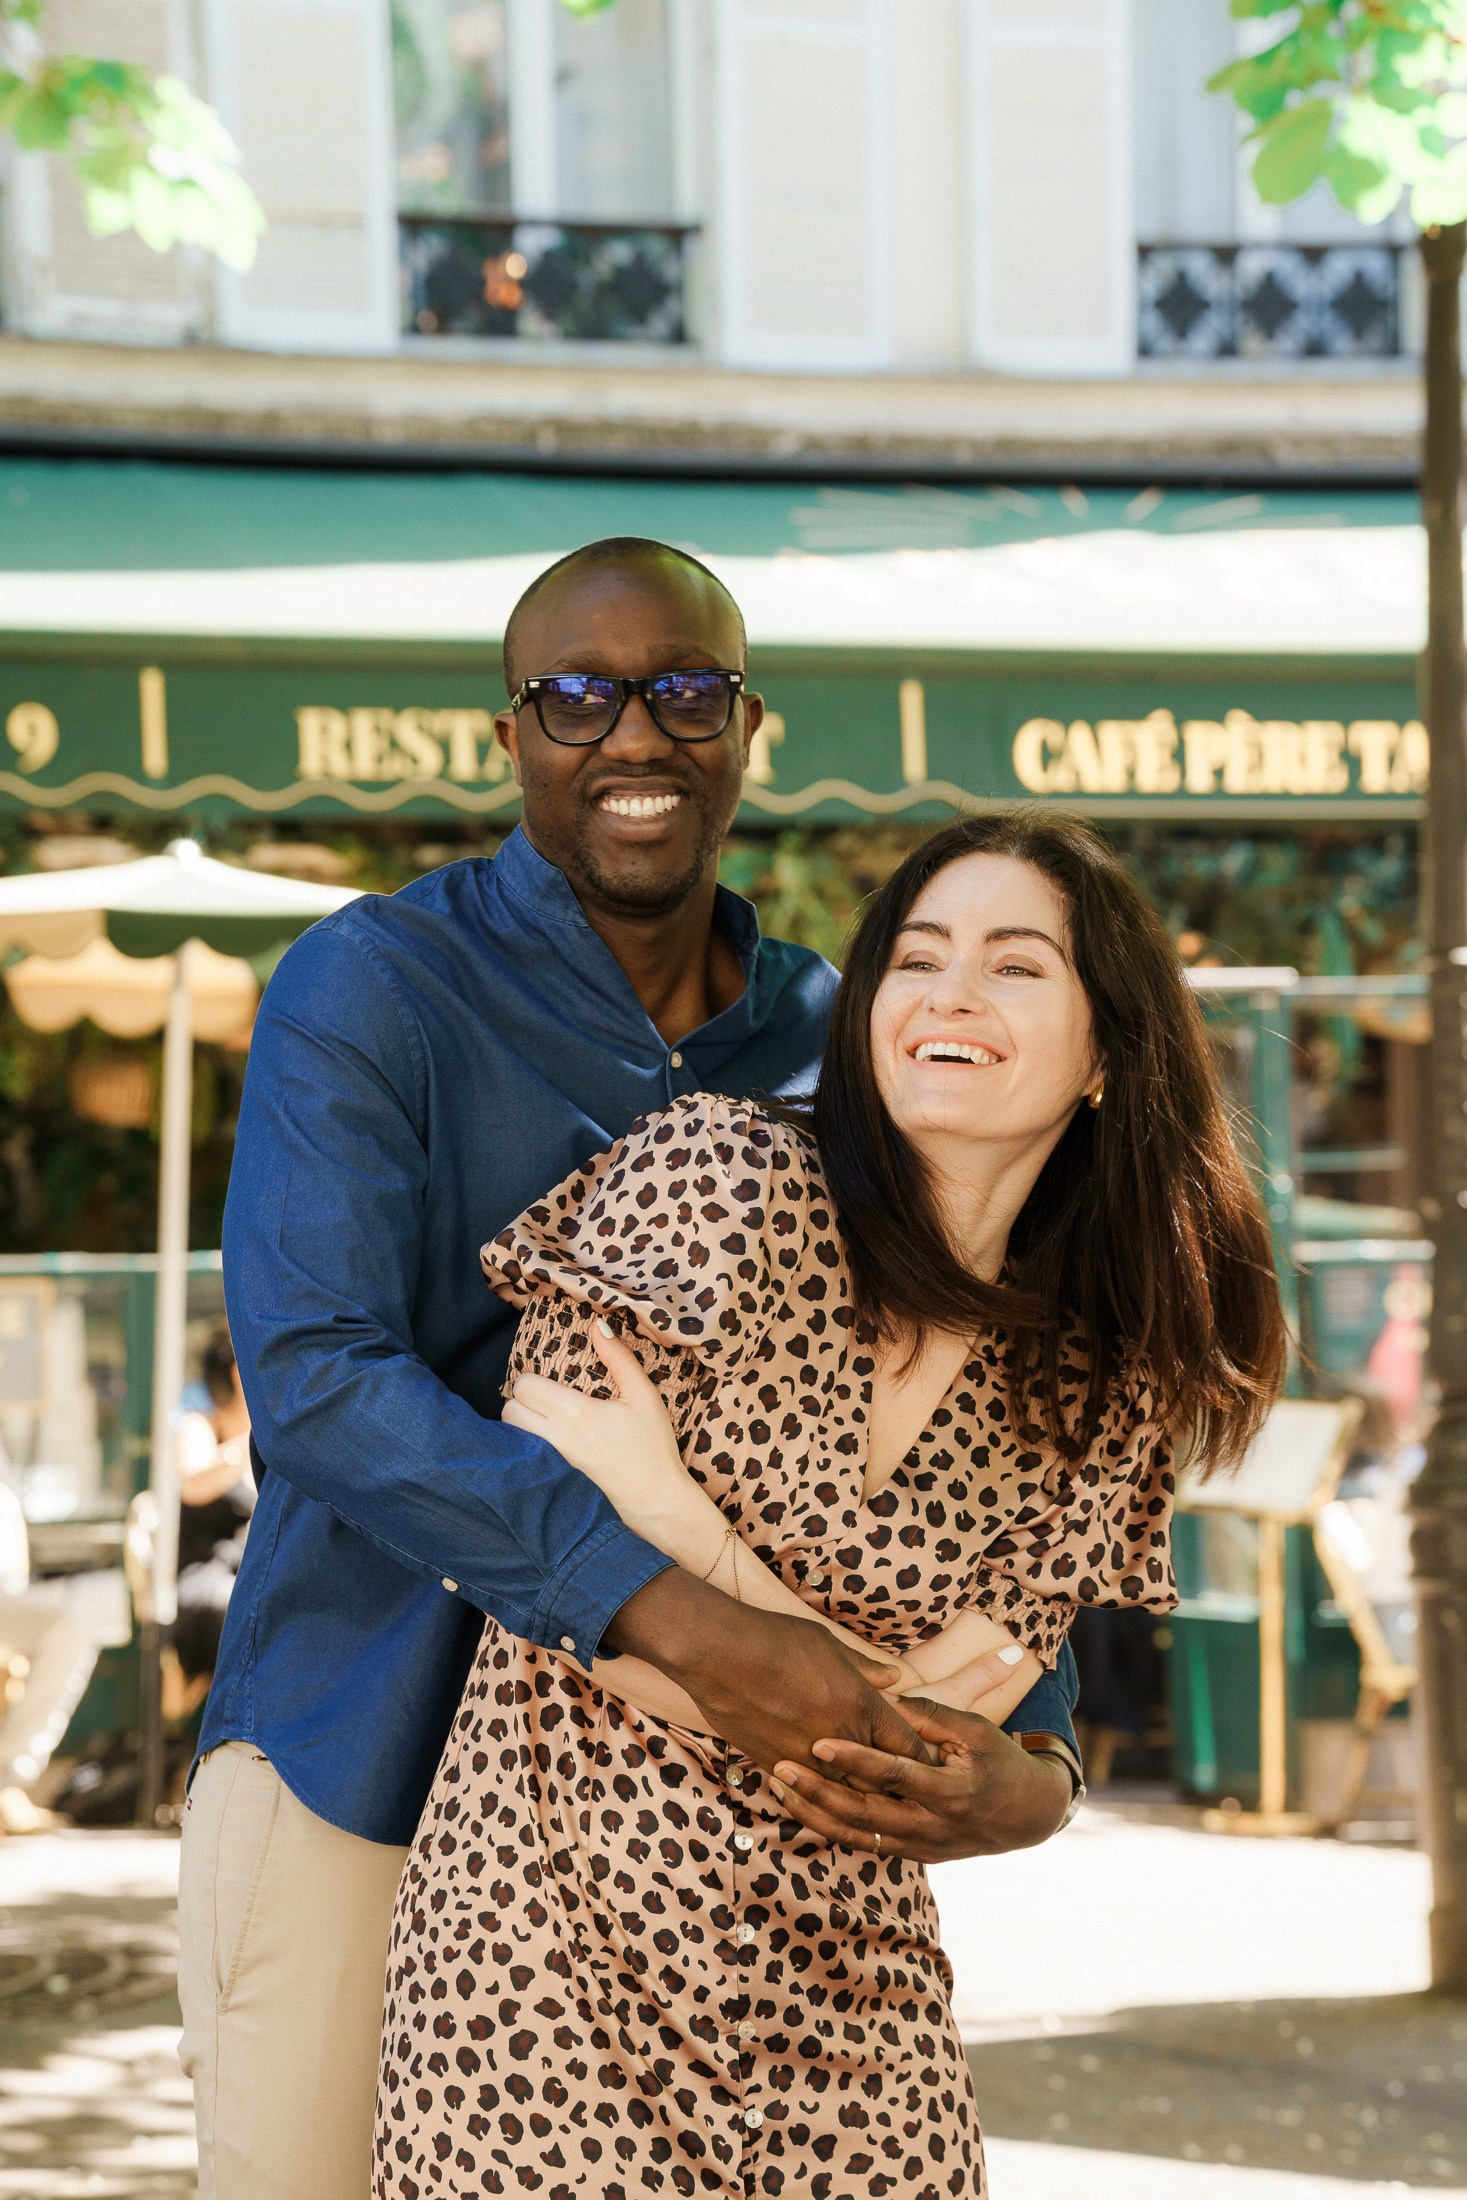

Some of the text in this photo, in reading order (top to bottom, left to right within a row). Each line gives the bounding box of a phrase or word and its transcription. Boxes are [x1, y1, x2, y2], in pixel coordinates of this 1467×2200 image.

[5, 700, 60, 775] 9
[1012, 707, 1181, 794] CAFÉ
[1182, 707, 1350, 795] PÈRE
